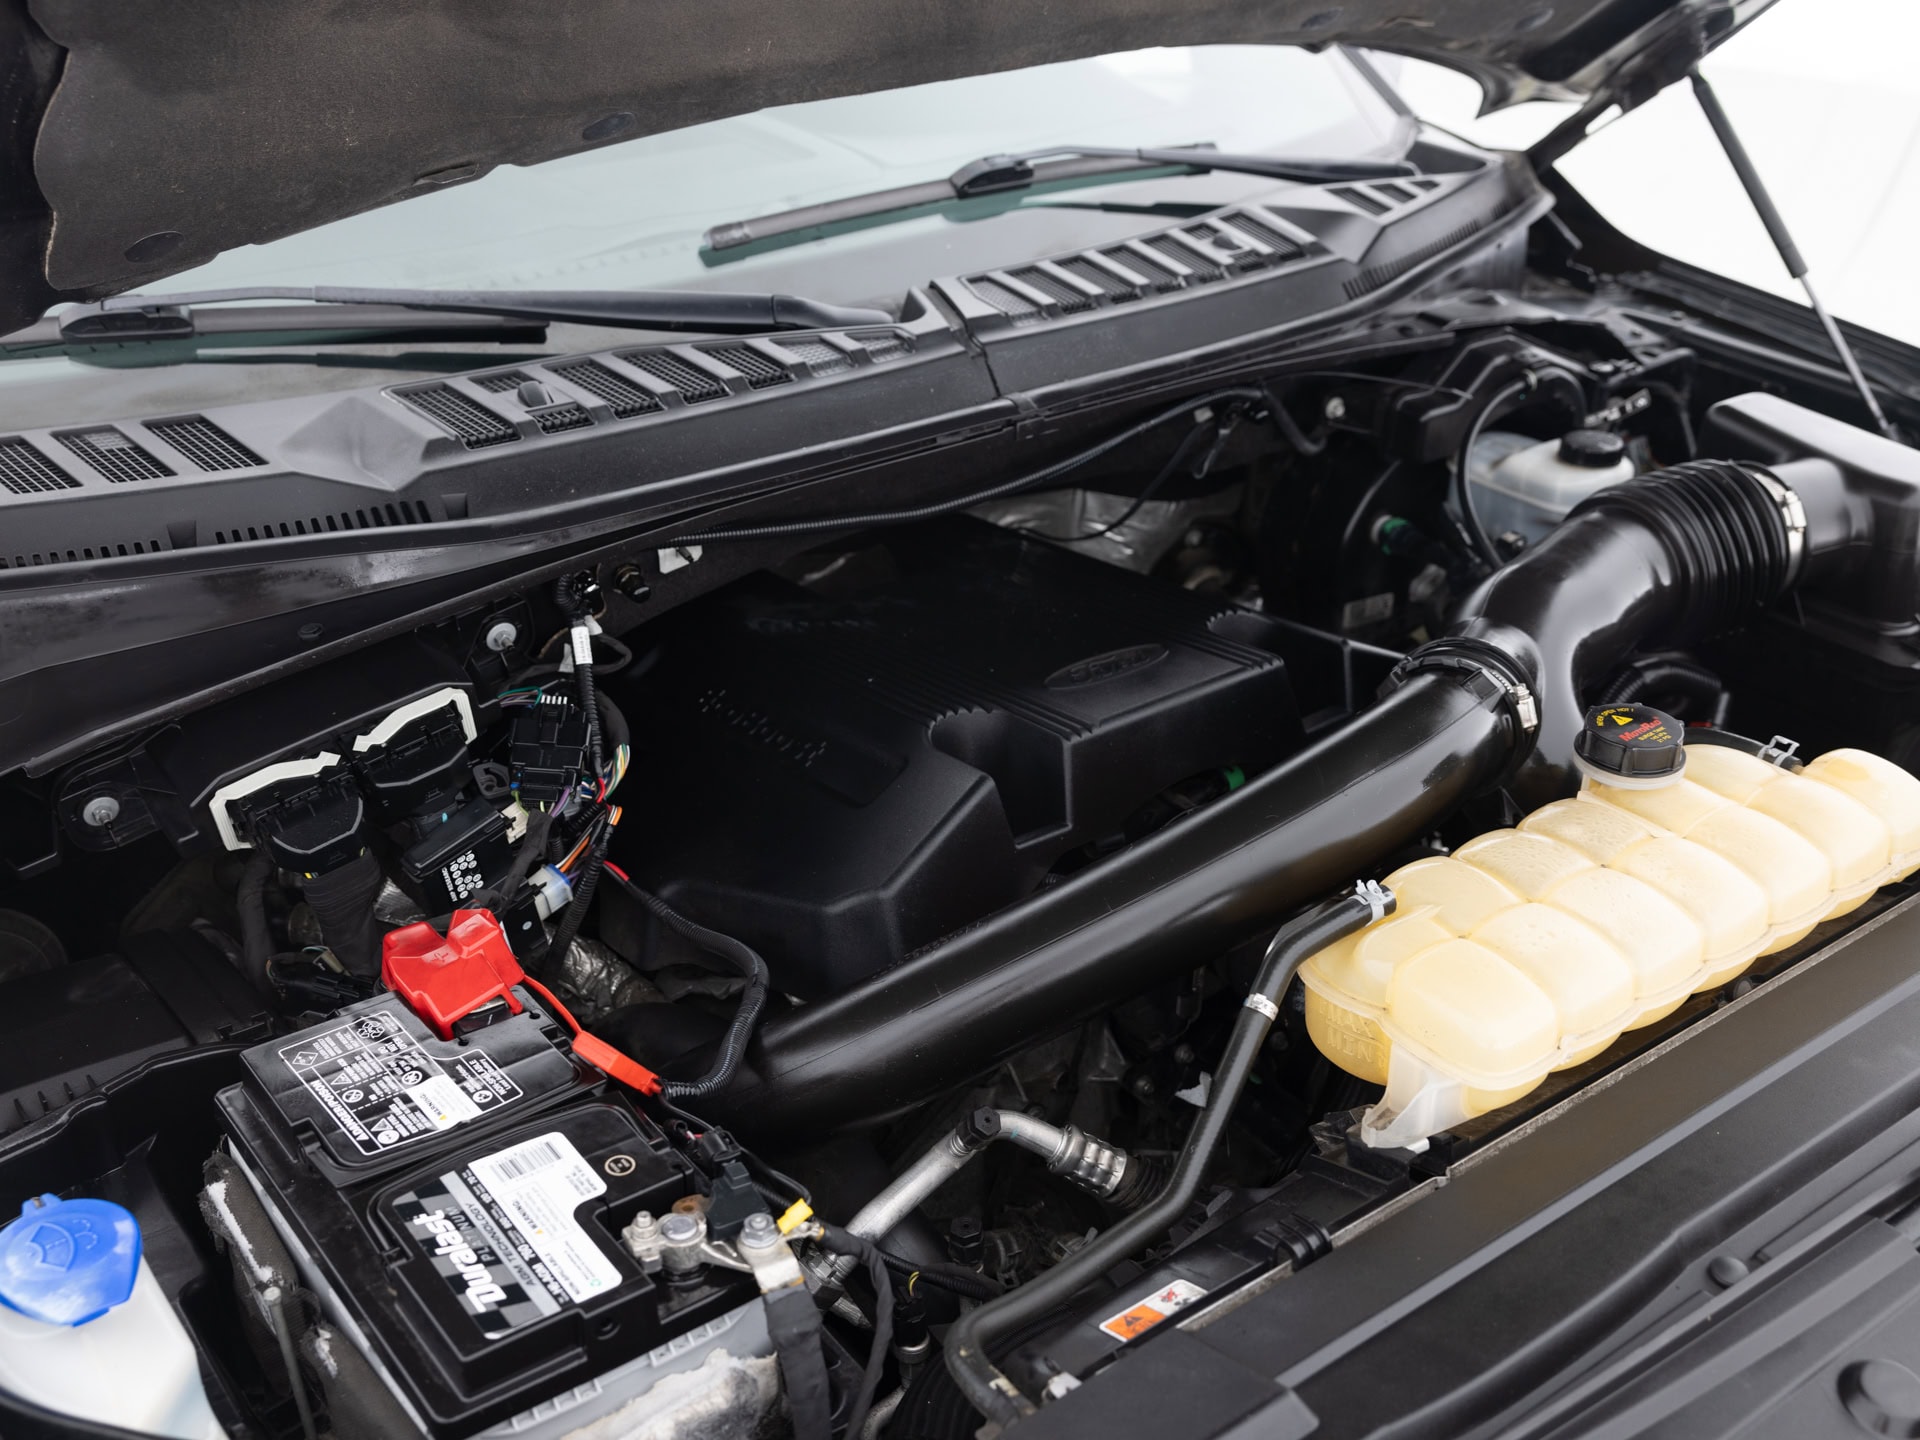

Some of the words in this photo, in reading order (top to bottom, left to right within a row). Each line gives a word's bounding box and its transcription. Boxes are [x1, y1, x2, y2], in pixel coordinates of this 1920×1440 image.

[1328, 1026, 1373, 1063] MIN
[309, 1079, 364, 1135] DANGER/POISON
[410, 1207, 507, 1313] Duralast
[445, 1204, 495, 1262] PLATINUM
[465, 1203, 517, 1262] TECHNOLOGY
[512, 1263, 536, 1287] AGM
